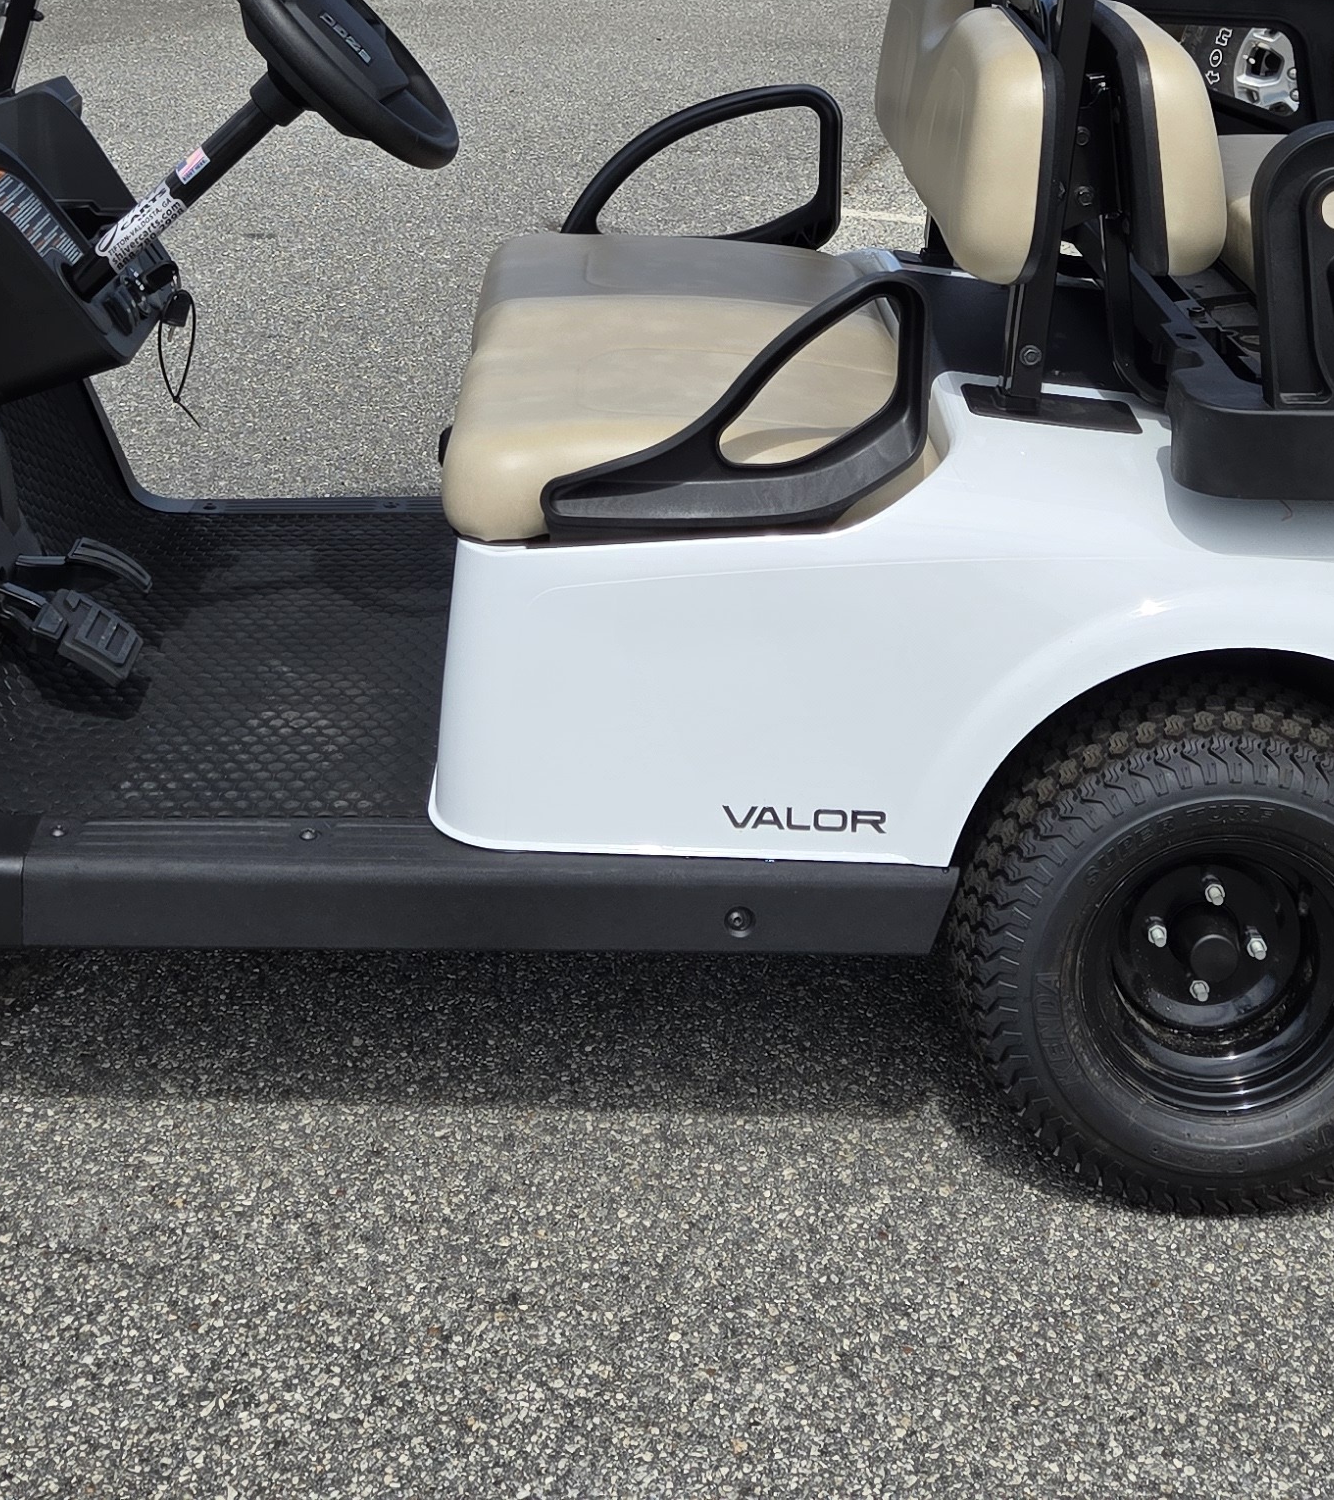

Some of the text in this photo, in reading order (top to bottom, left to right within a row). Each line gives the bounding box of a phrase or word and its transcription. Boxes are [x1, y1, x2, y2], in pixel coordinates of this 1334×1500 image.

[112, 201, 181, 265] shivercarts.com
[722, 804, 887, 834] VALOR
[1084, 815, 1175, 887] SUPER
[1034, 972, 1083, 1087] KENDA
